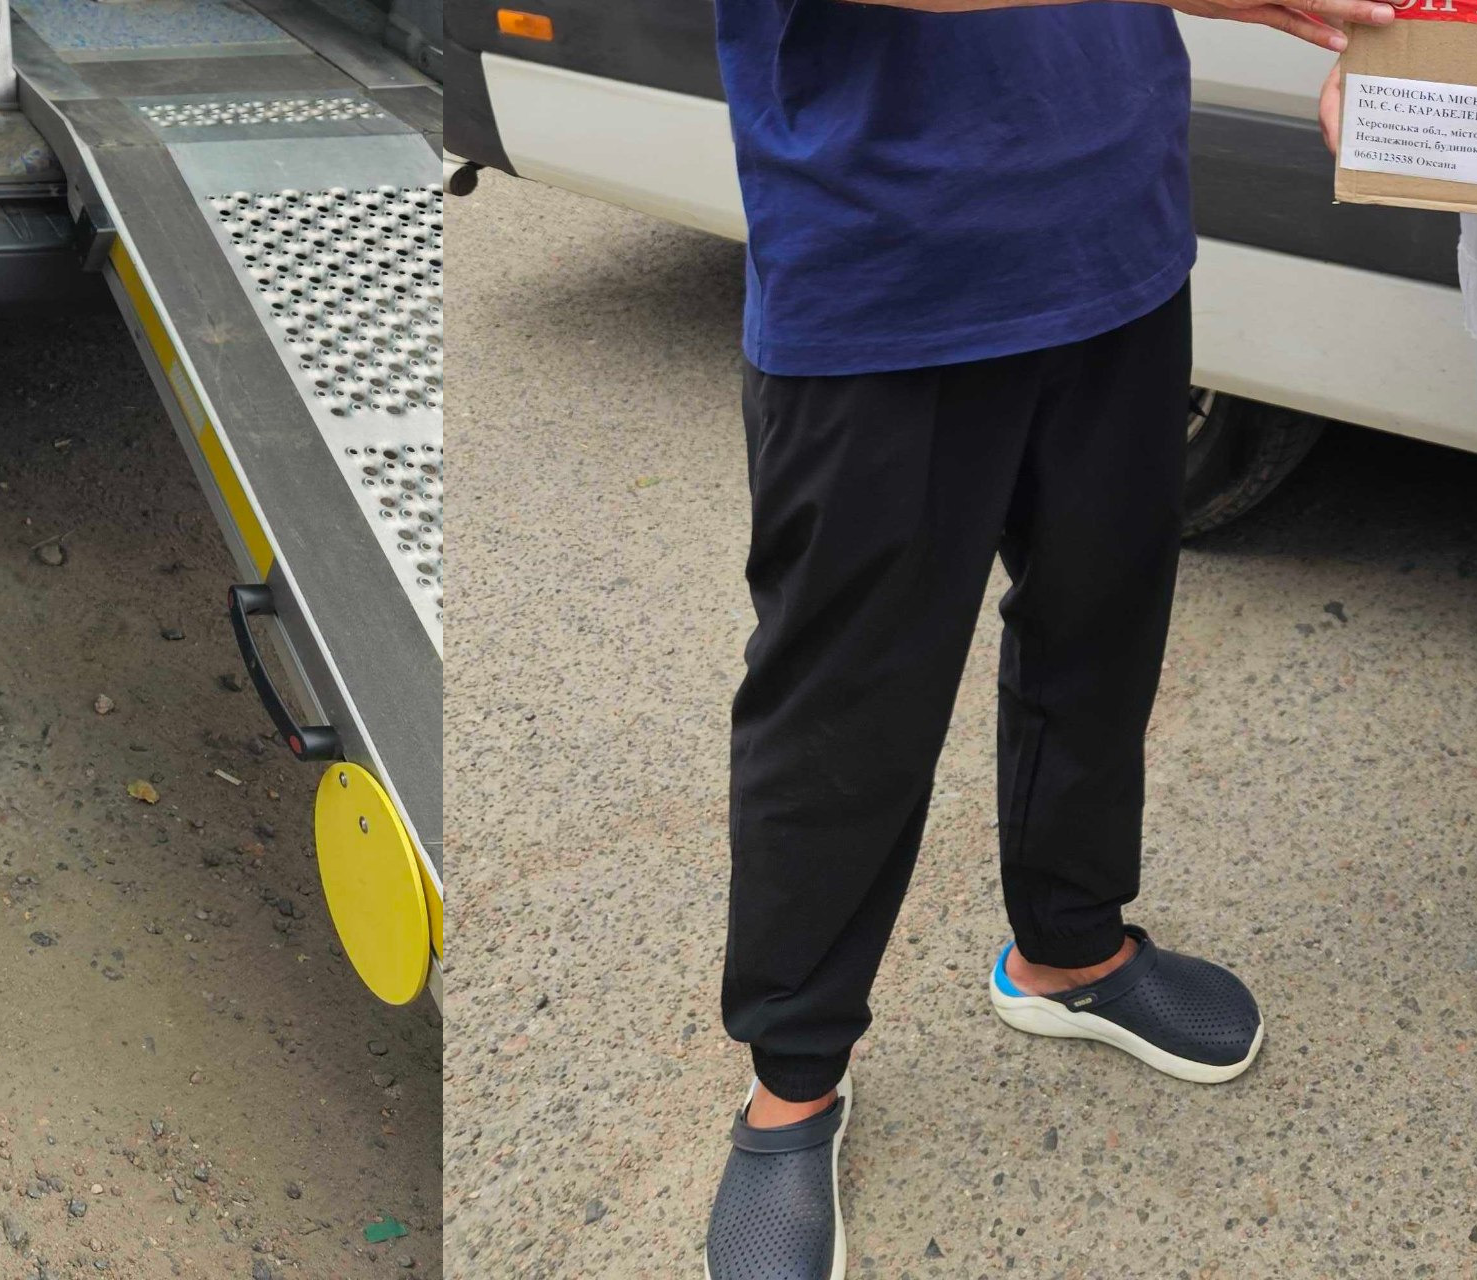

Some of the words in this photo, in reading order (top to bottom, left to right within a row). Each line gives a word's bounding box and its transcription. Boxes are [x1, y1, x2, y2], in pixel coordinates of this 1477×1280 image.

[1359, 84, 1445, 103] ХЕРСОНСЬКА
[1356, 117, 1419, 135] Херсонська
[1356, 131, 1432, 150] Незалежності,
[1354, 149, 1414, 164] 0663123538
[1416, 156, 1457, 170] Оксана
